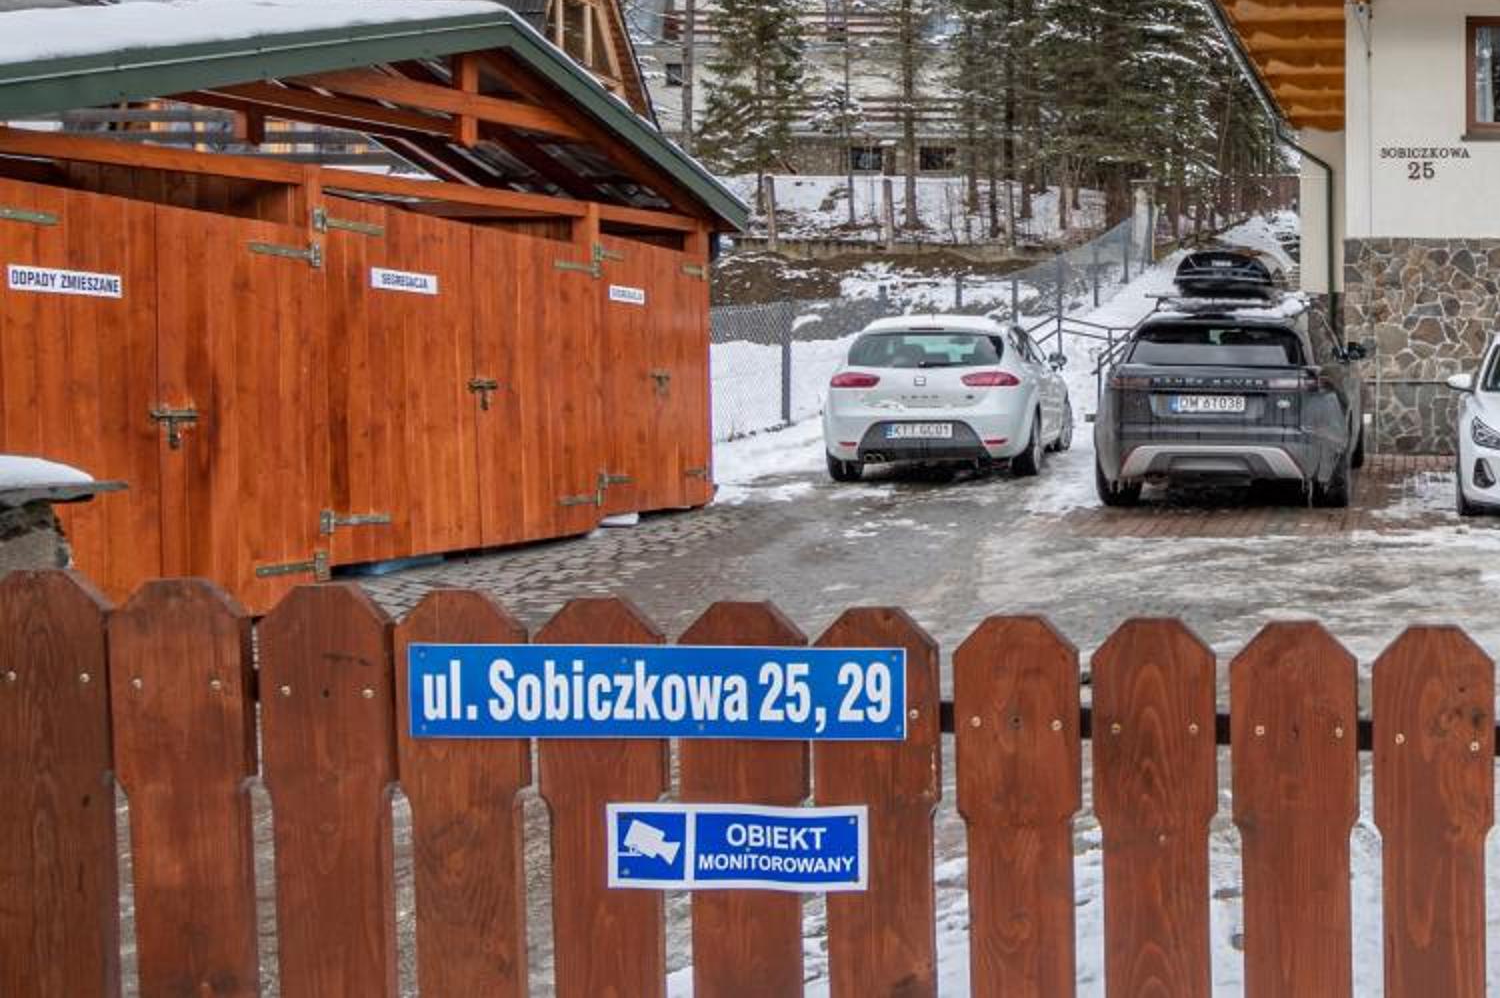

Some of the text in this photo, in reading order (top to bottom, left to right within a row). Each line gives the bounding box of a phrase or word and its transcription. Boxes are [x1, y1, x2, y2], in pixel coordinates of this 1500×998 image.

[1380, 147, 1470, 159] SOBICZKOWA
[1407, 161, 1435, 180] 25
[11, 269, 119, 293] ODPADY ZMIESZANE
[423, 658, 892, 733] ul. Sobiczkowa 25, 29
[726, 823, 827, 850] OBIEKT
[698, 853, 855, 873] MONITOROWANY
